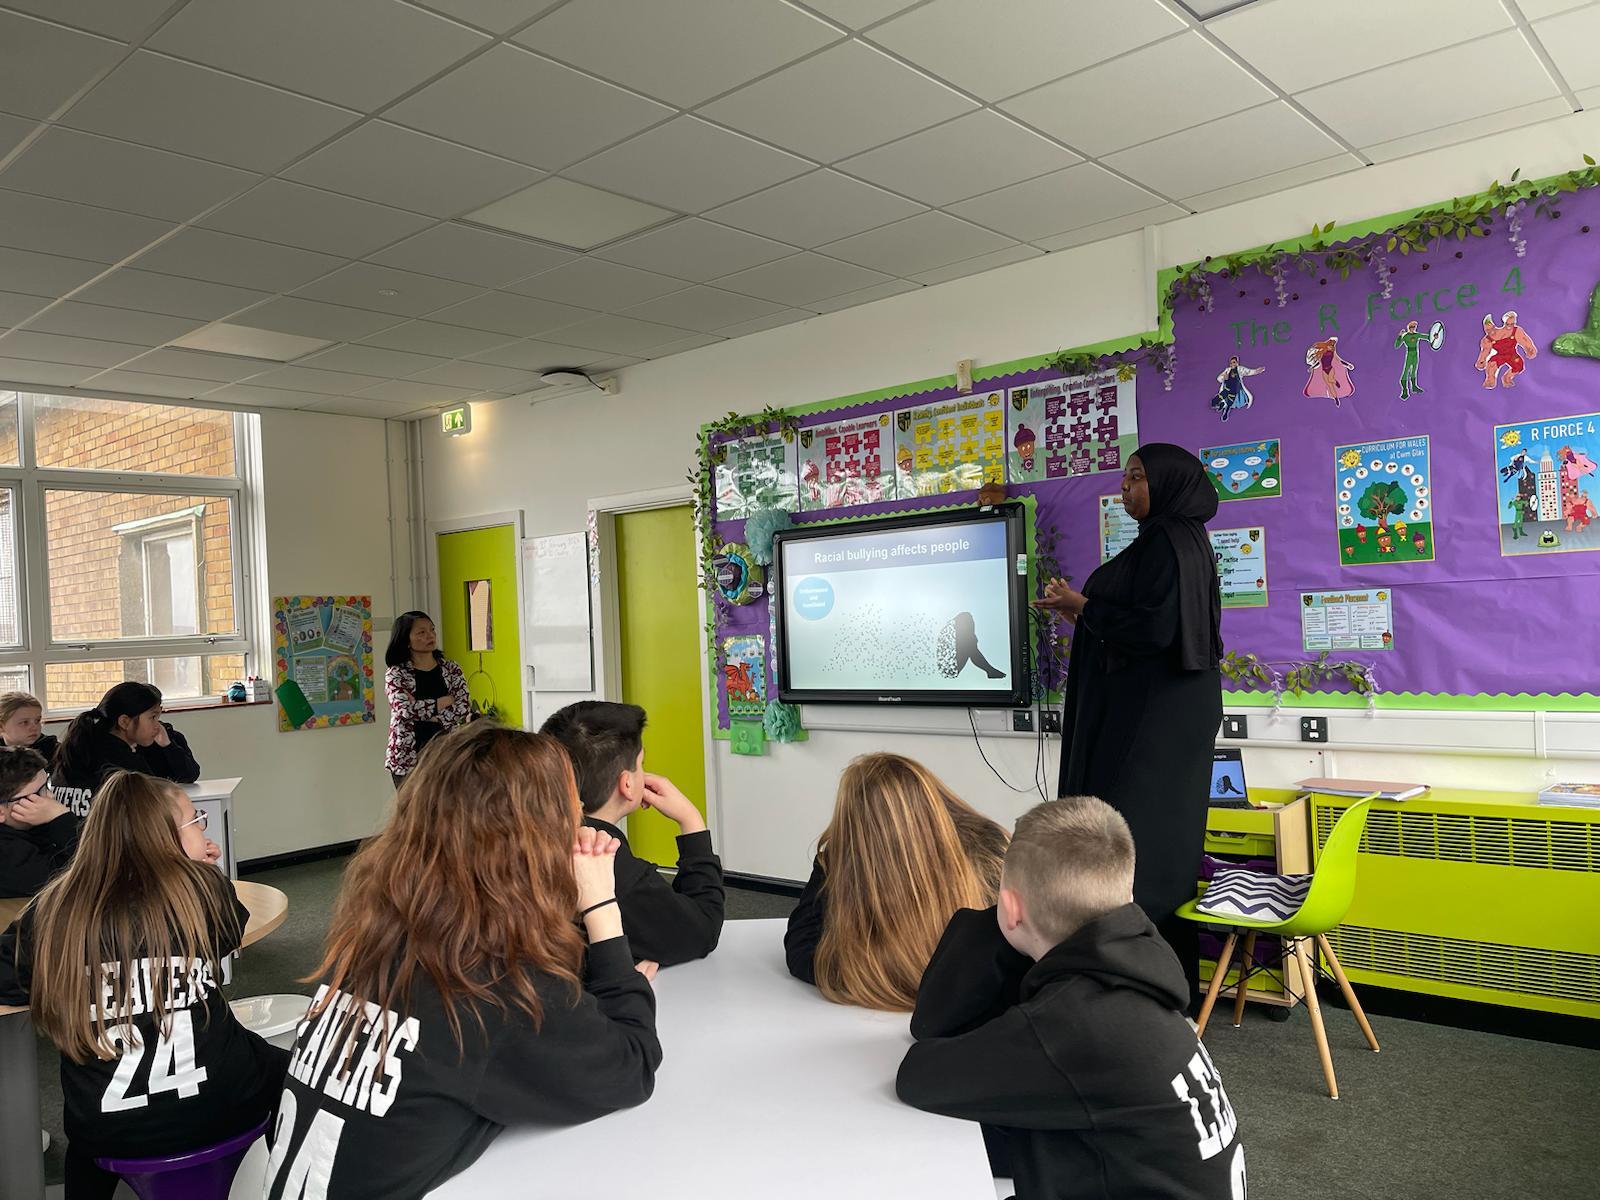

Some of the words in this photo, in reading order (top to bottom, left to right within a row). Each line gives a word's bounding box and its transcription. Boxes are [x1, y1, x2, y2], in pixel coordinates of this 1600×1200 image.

[1230, 319, 1291, 349] The
[1318, 303, 1340, 334] R
[1366, 282, 1479, 322] Force
[1502, 265, 1527, 297] 4
[1531, 427, 1540, 441] R
[1543, 421, 1584, 440] FORCE
[1587, 420, 1595, 434] 4
[1361, 442, 1395, 454] CURRICULUM
[1396, 441, 1407, 450] FOR
[1407, 438, 1426, 448] WALES
[814, 551, 845, 564] Racial
[847, 546, 888, 562] bullying
[890, 543, 928, 557] affects
[931, 538, 970, 555] people
[98, 1009, 208, 1113] 24
